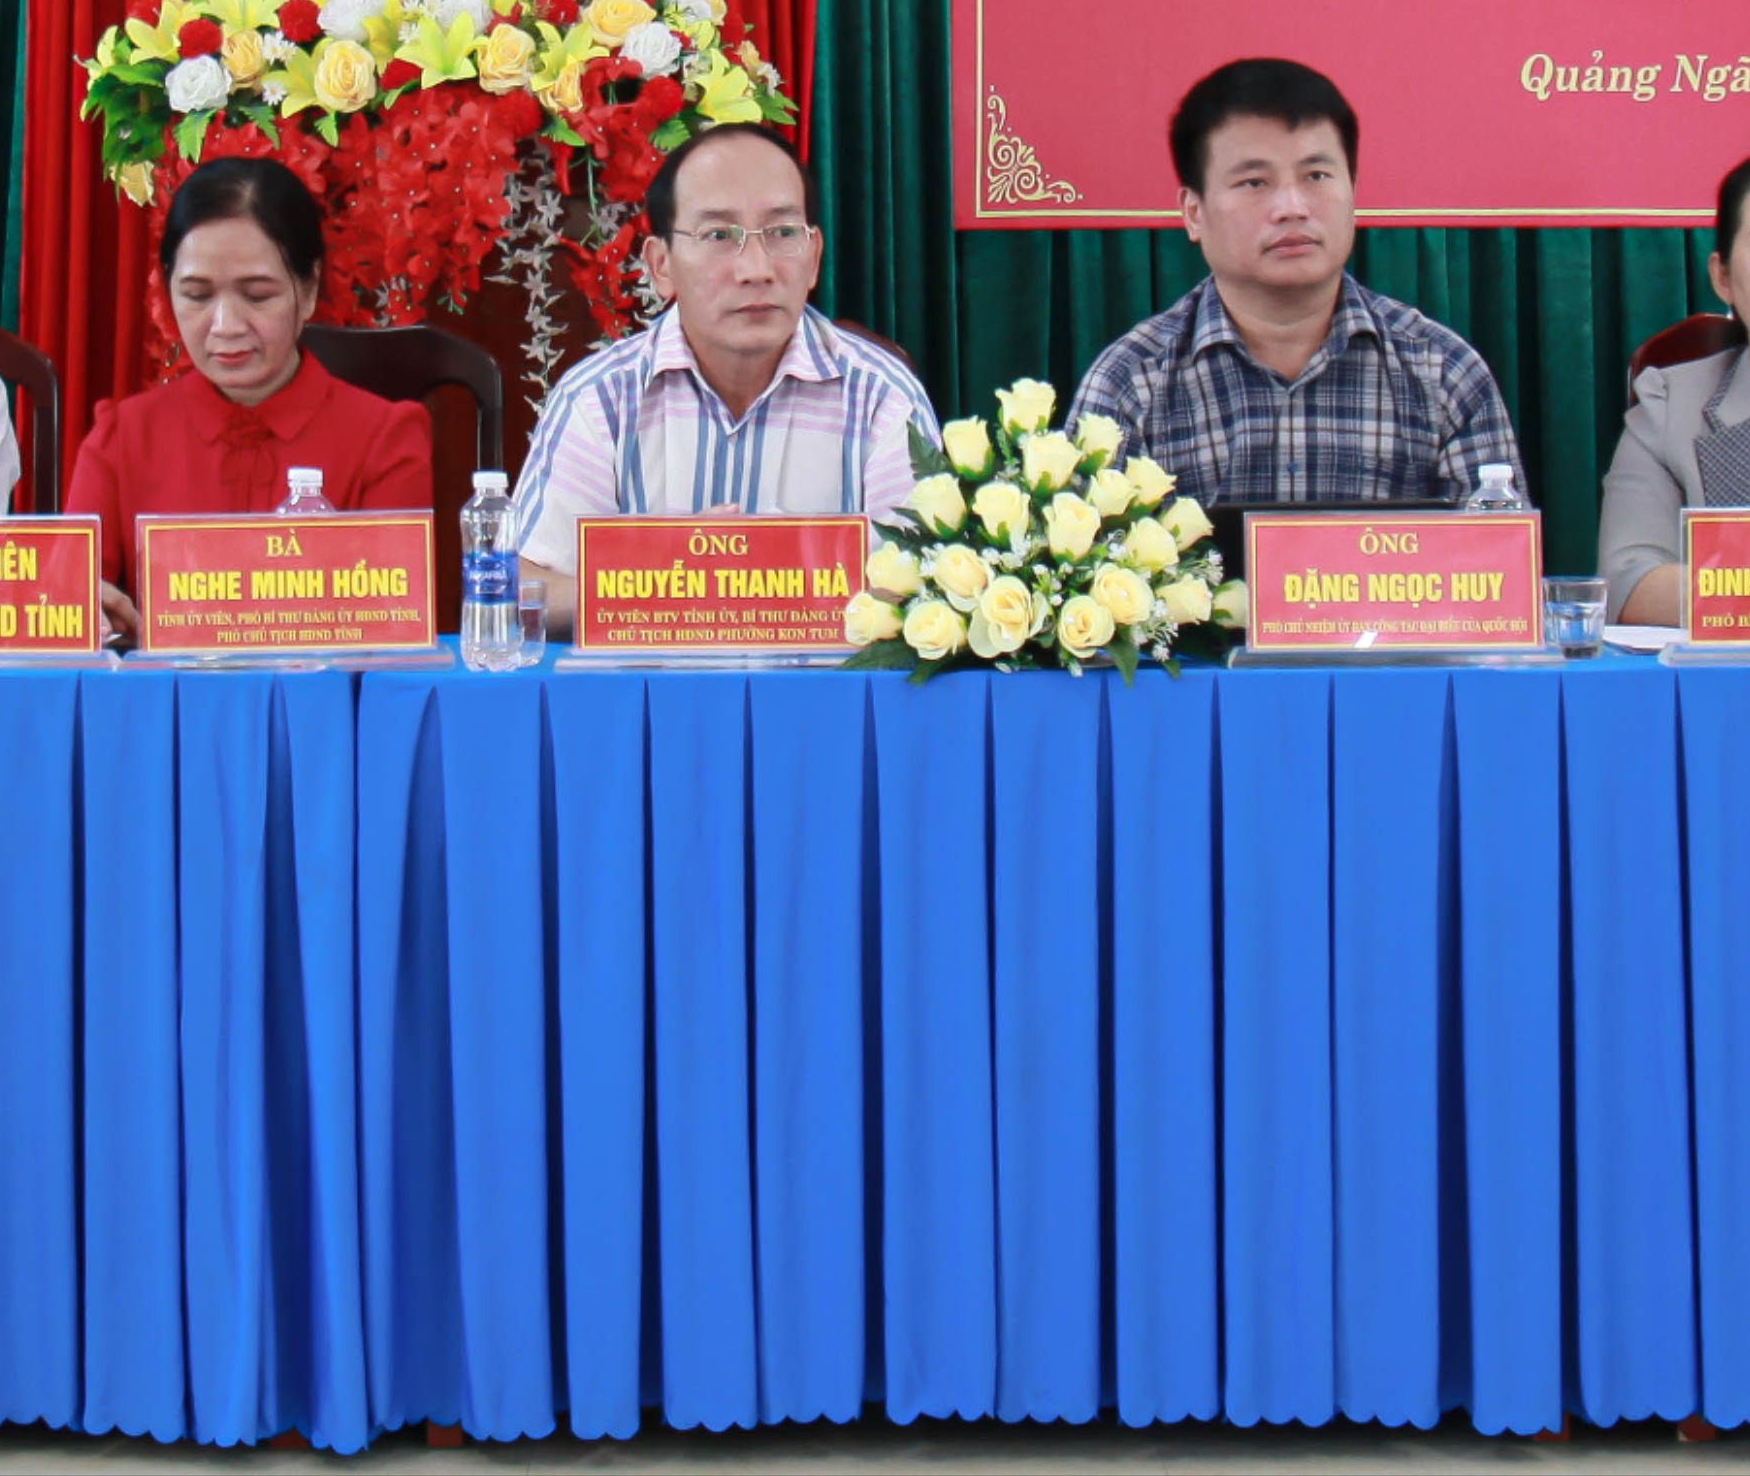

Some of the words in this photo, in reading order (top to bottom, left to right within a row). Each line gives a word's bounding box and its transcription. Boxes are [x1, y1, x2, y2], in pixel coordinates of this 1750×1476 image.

[1521, 50, 1661, 101] Quảng
[267, 529, 302, 556] BÀ
[689, 528, 747, 555] ÔNG
[1360, 527, 1418, 554] ÔNG
[170, 571, 241, 600] NGHE
[252, 570, 323, 599] MINH
[333, 560, 407, 597] HỒNG
[597, 560, 706, 598] NGUYỄN
[714, 570, 803, 597] THANH
[813, 562, 849, 597] HÀ
[1284, 569, 1359, 608] ĐẶNG
[1368, 573, 1442, 607] NGỌC
[1451, 573, 1503, 601] HUY
[25, 594, 82, 637] TỈNH
[1703, 613, 1735, 627] PHÓ
